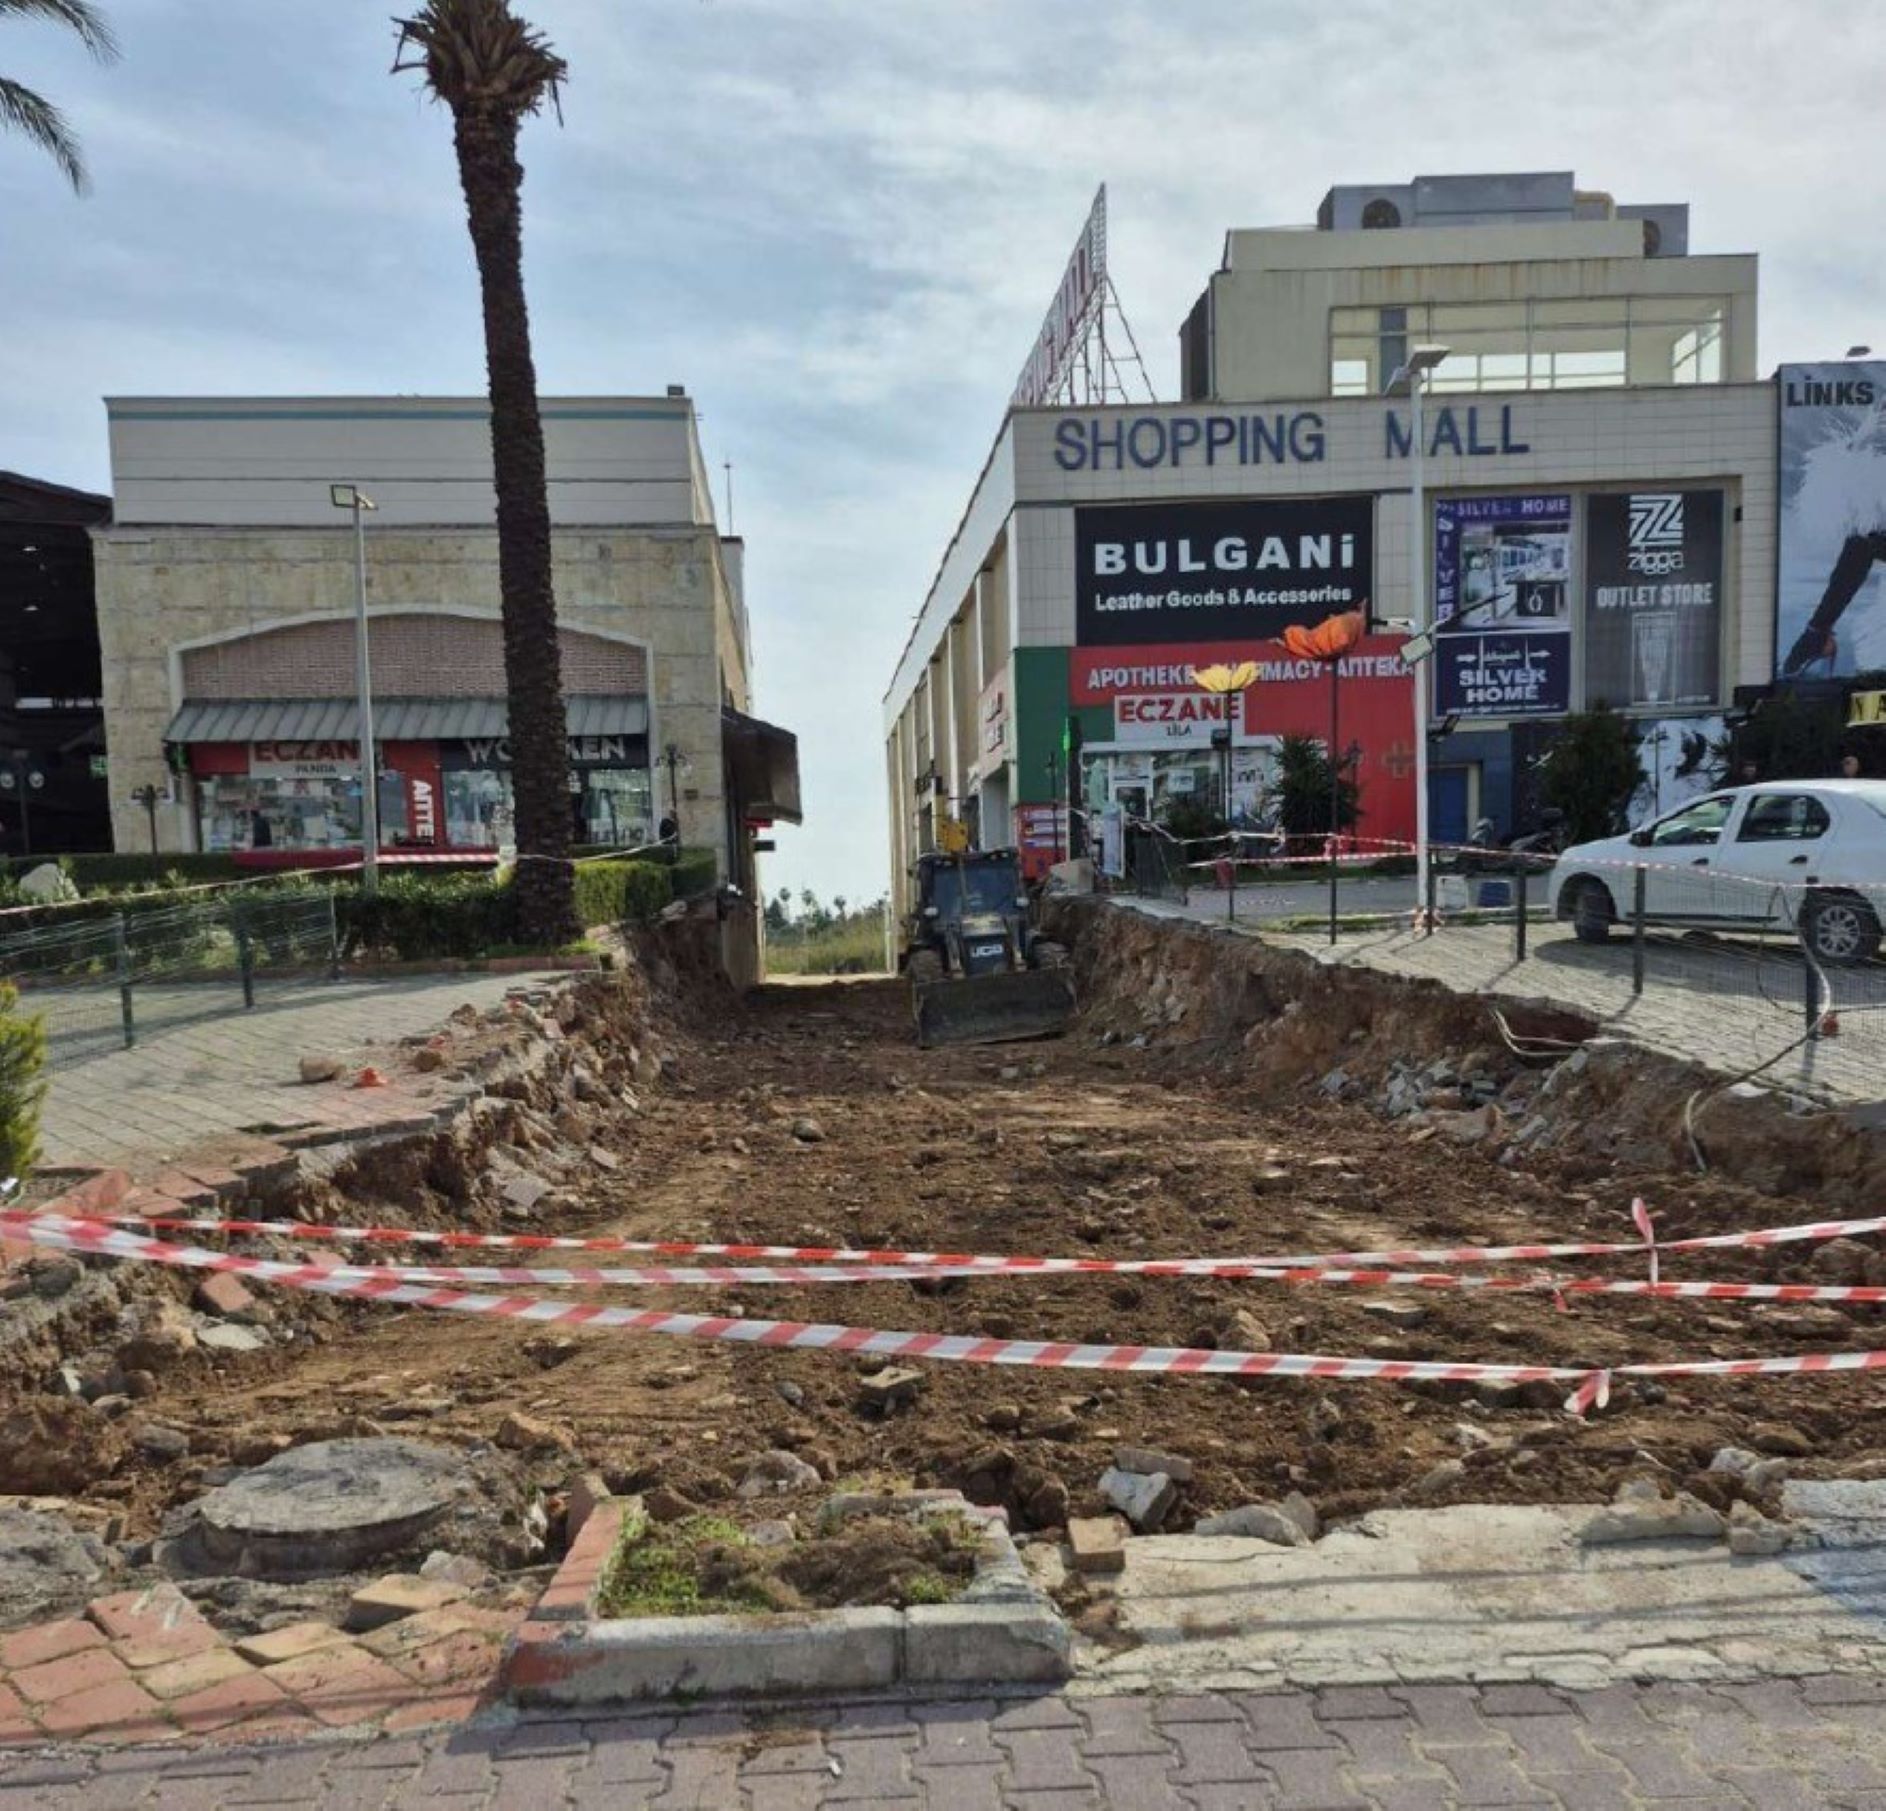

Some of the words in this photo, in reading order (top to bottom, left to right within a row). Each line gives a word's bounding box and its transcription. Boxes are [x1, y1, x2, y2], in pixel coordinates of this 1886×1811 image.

[1054, 412, 1325, 470] SHOPPING
[1385, 404, 1530, 459] MALL
[1521, 498, 1568, 514] HOME
[1095, 592, 1163, 611] Leather
[1166, 589, 1224, 607] Goods
[1227, 588, 1240, 605] &
[1243, 585, 1352, 604] Accessories
[1597, 586, 1658, 608] OUTLET
[1661, 583, 1712, 605] STORE
[1088, 664, 1197, 690] APOTHEKE
[1459, 668, 1546, 686] SILVER
[1466, 684, 1539, 703] HOME
[1118, 698, 1240, 722] ECZANE
[254, 741, 363, 762] ECZAN
